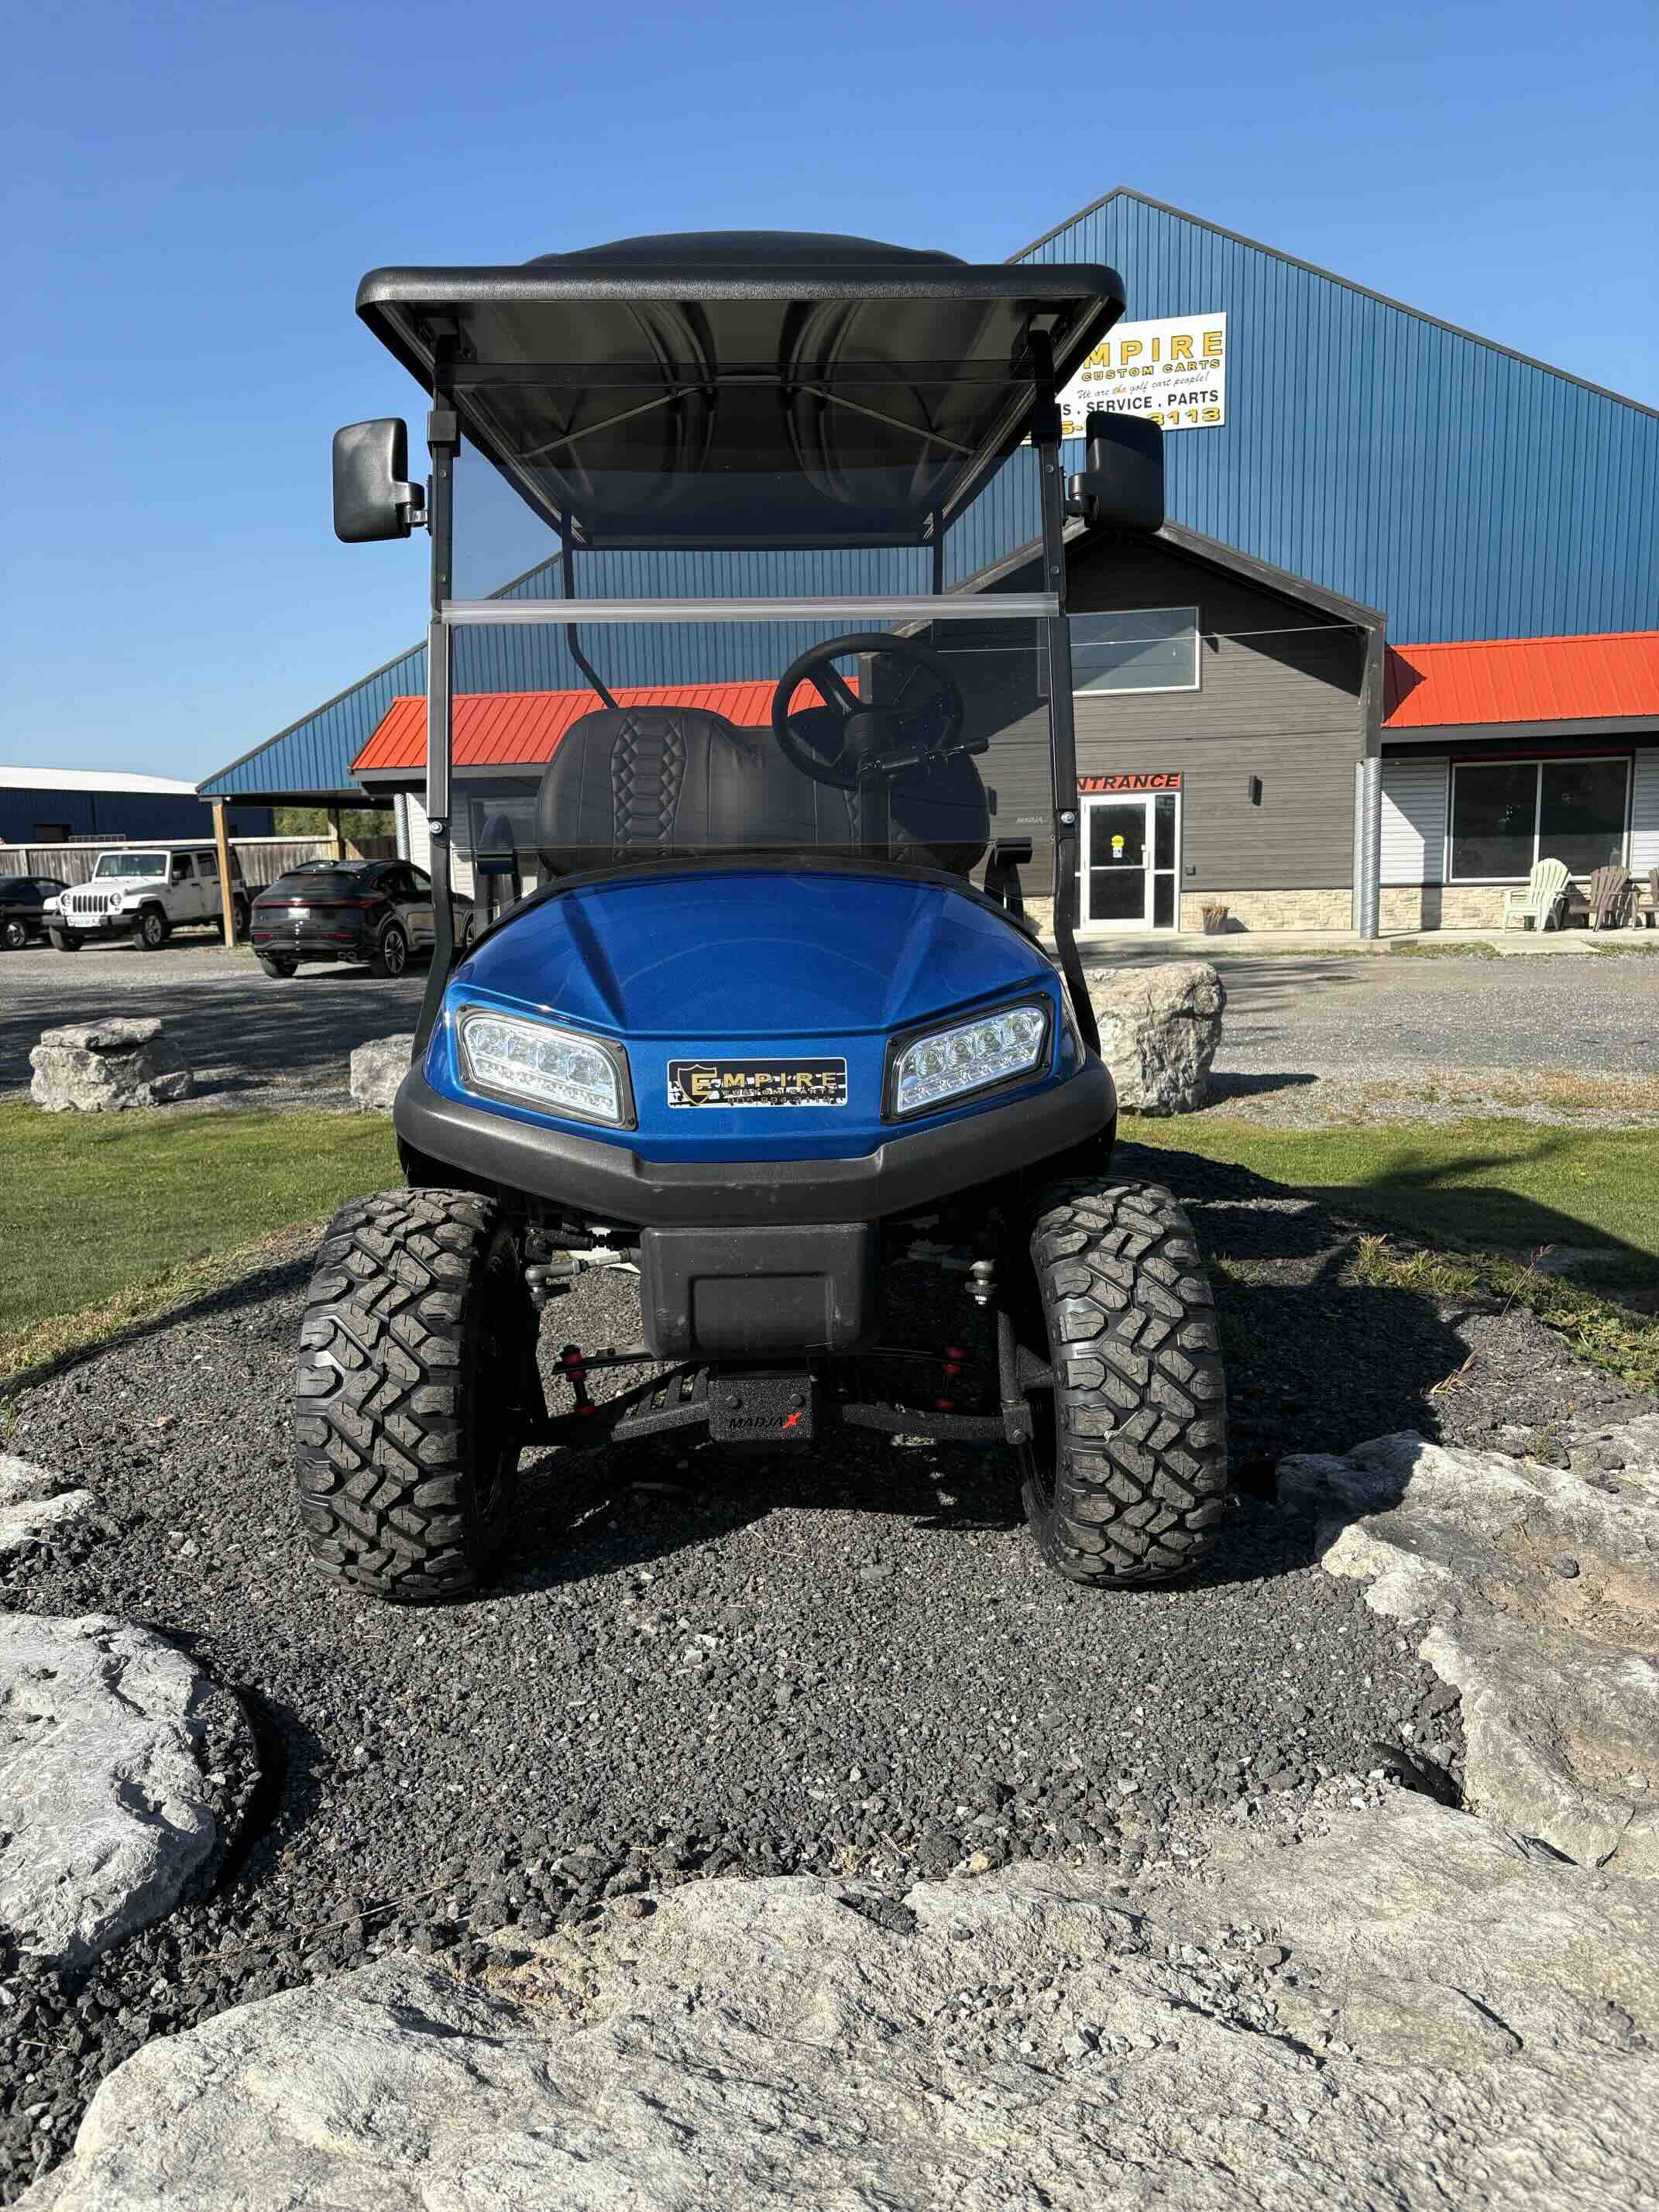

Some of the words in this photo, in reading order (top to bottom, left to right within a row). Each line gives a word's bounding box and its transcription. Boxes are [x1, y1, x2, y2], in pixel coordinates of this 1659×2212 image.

[1084, 331, 1223, 369] MPIRE
[1081, 366, 1153, 382] CUSTOM
[1163, 359, 1220, 373] CARTS
[1112, 384, 1128, 395] the
[1129, 380, 1149, 395] golf
[1152, 379, 1171, 388] cart
[1087, 396, 1152, 414] SERVICE
[1168, 390, 1219, 405] PARTS
